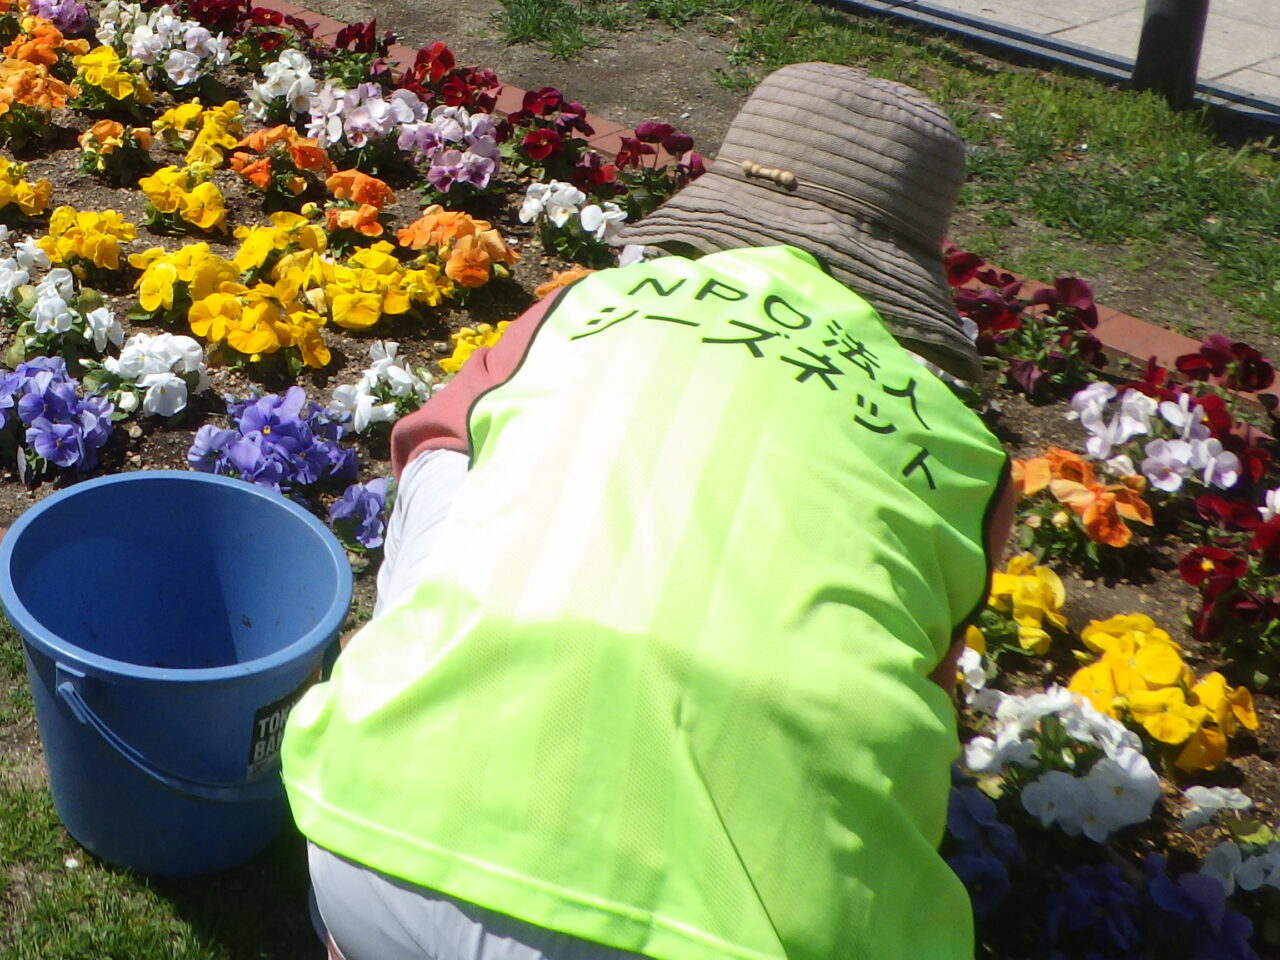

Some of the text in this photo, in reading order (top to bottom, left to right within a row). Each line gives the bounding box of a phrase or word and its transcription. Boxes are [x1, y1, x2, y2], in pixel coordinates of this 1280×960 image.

[570, 306, 937, 491] シーズネット
[627, 277, 932, 431] NPO法人
